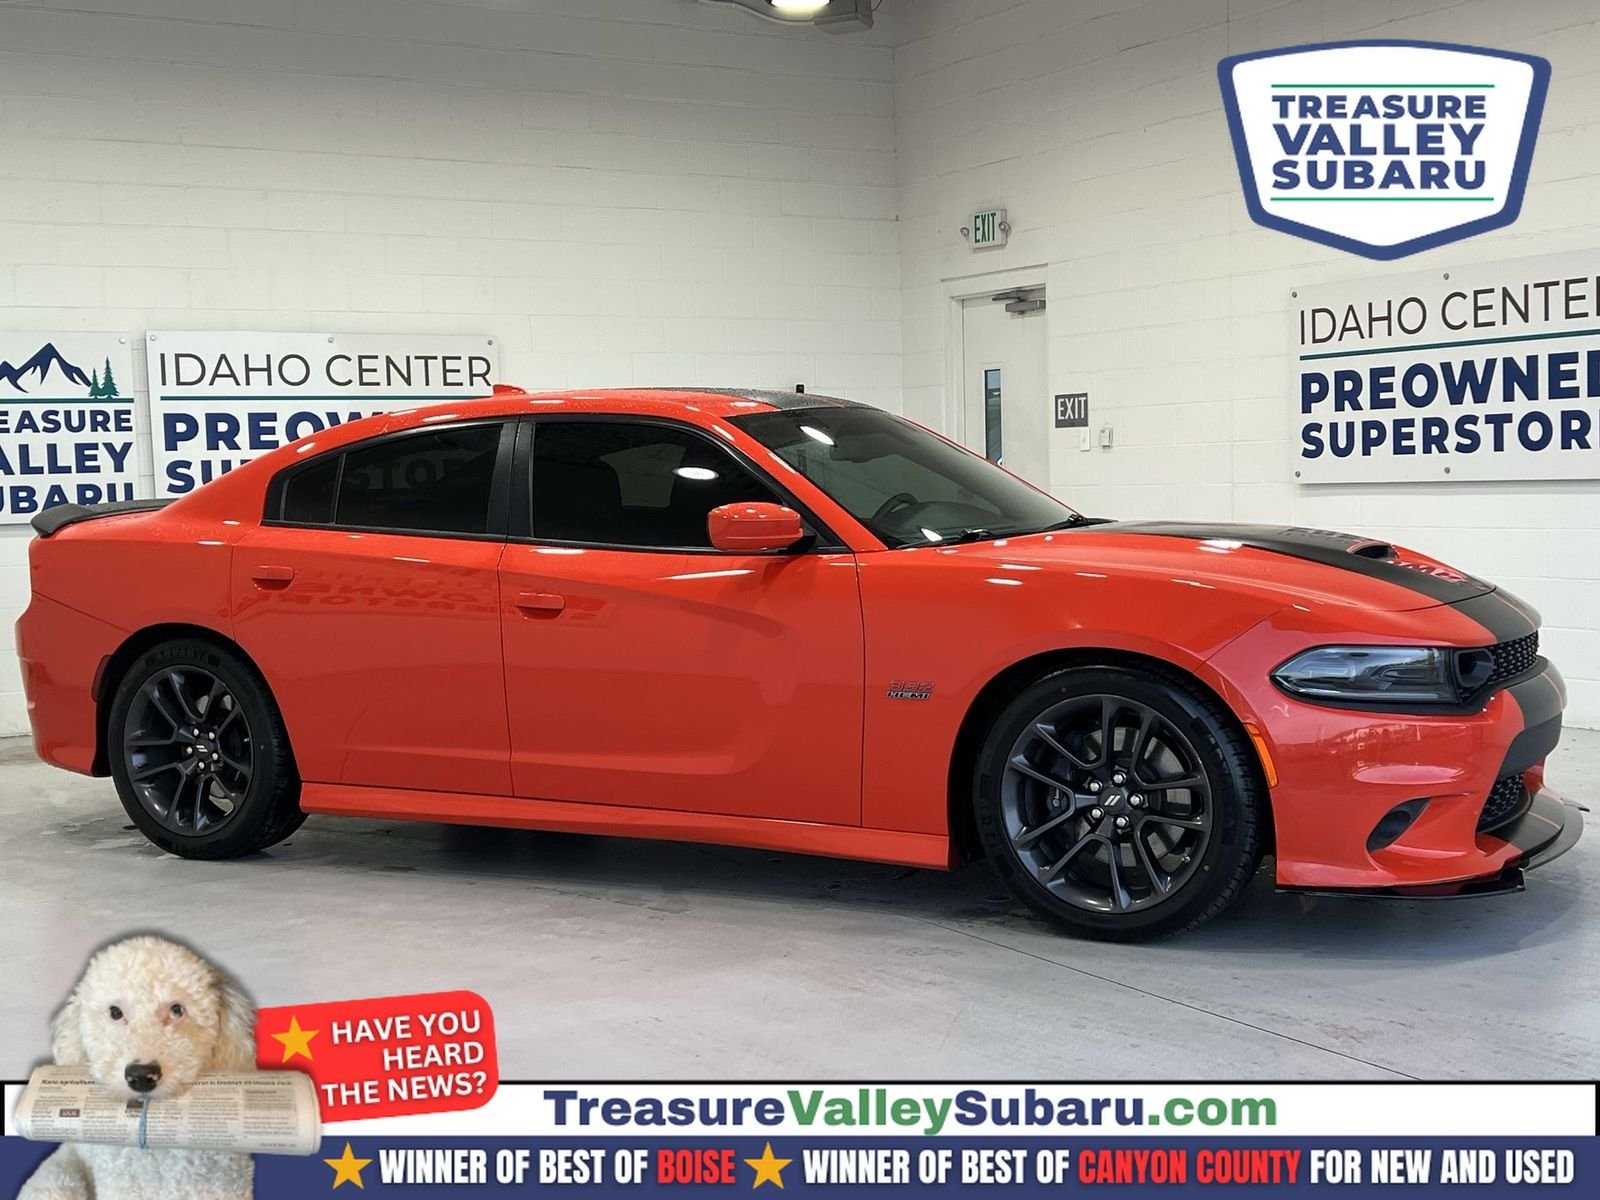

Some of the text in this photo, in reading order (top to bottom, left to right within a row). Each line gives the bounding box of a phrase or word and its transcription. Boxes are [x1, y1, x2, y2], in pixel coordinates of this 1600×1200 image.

[973, 211, 997, 244] EXIT
[1300, 275, 1600, 345] IDAHO CENTE
[160, 352, 493, 388] IDAHO CENTER
[1057, 396, 1087, 421] EXIT
[1301, 408, 1600, 459] SUPERSTOR
